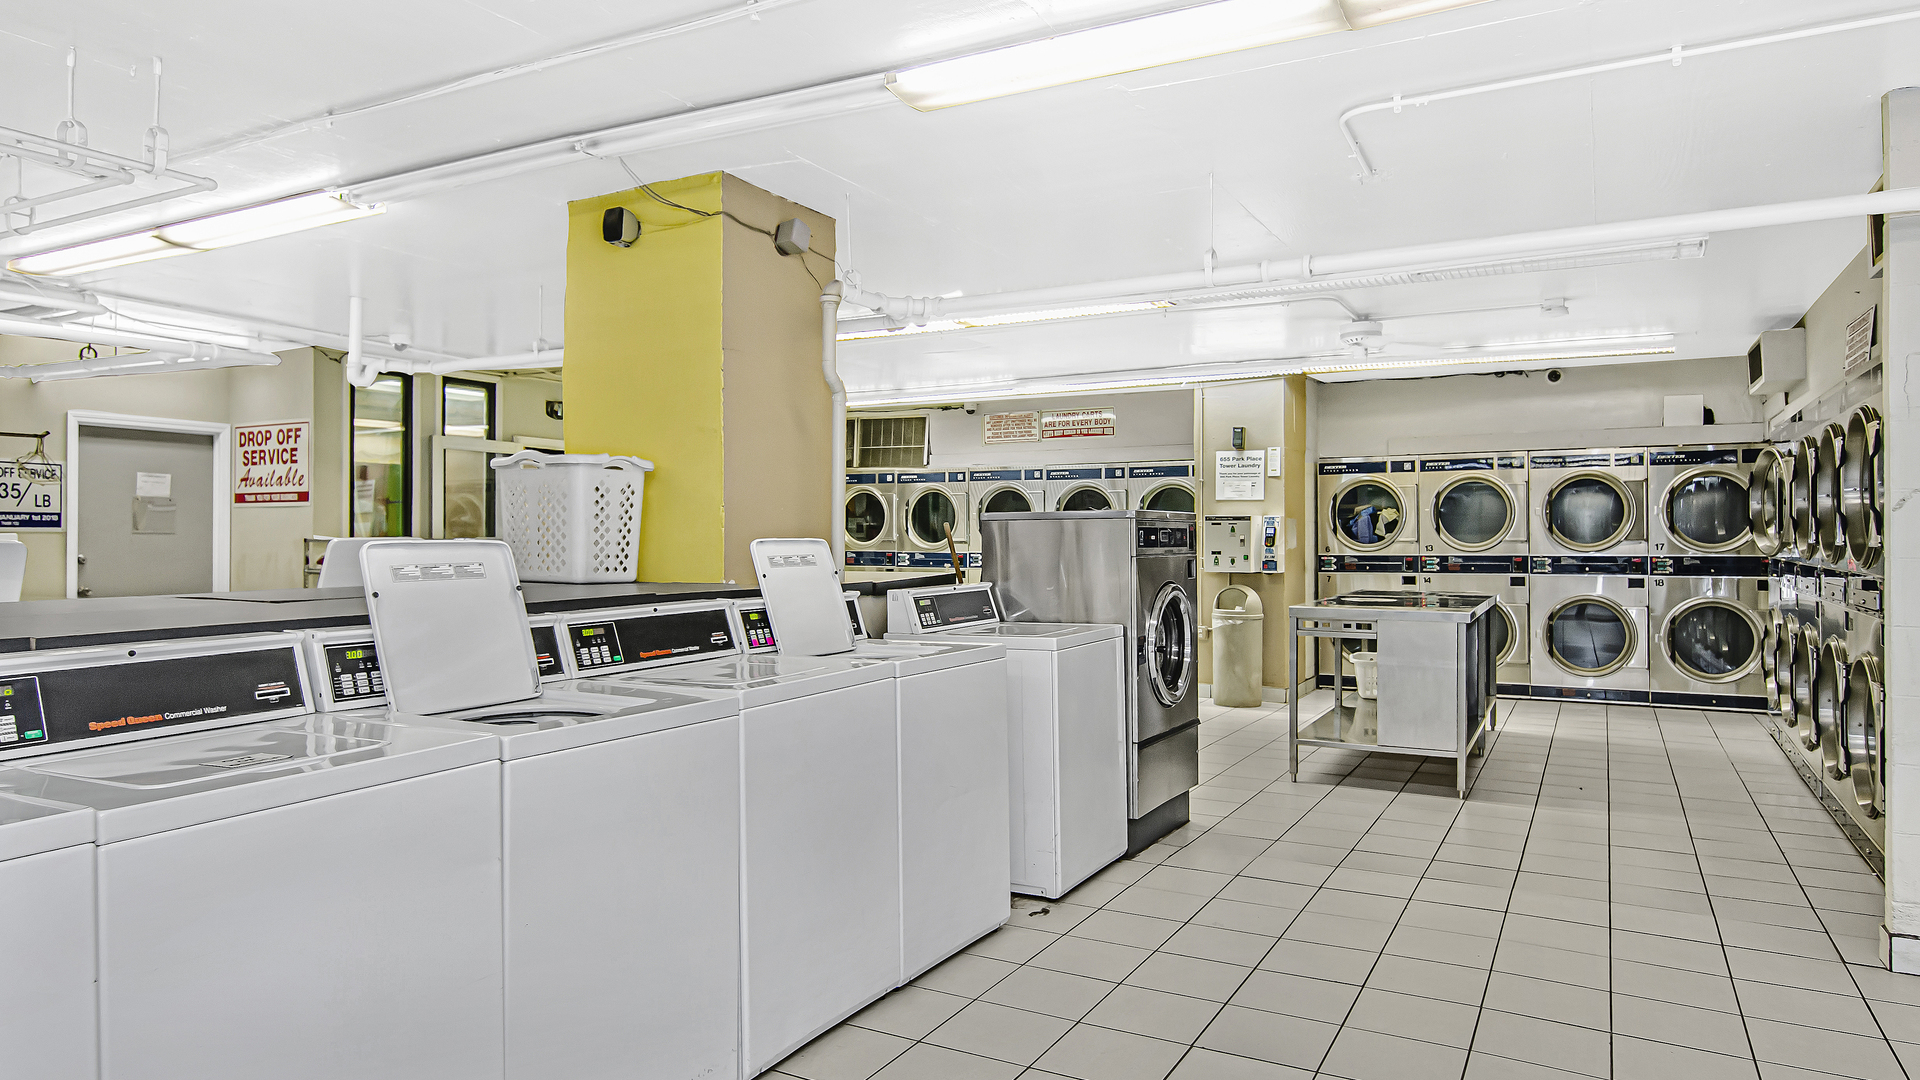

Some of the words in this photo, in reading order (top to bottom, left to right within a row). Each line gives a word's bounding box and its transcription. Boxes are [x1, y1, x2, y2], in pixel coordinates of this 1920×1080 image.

[1051, 411, 1080, 420] LAUNDRY
[1072, 419, 1093, 427] EVERY
[238, 429, 273, 447] DROP
[276, 427, 302, 445] OFF
[242, 447, 298, 467] SERVICE
[237, 466, 305, 489] Available
[35, 494, 51, 507] LB
[1655, 543, 1665, 551] 17
[88, 717, 126, 731] Speed
[126, 714, 163, 725] Queen
[164, 708, 203, 720] Commercial
[203, 705, 227, 714] Washer
